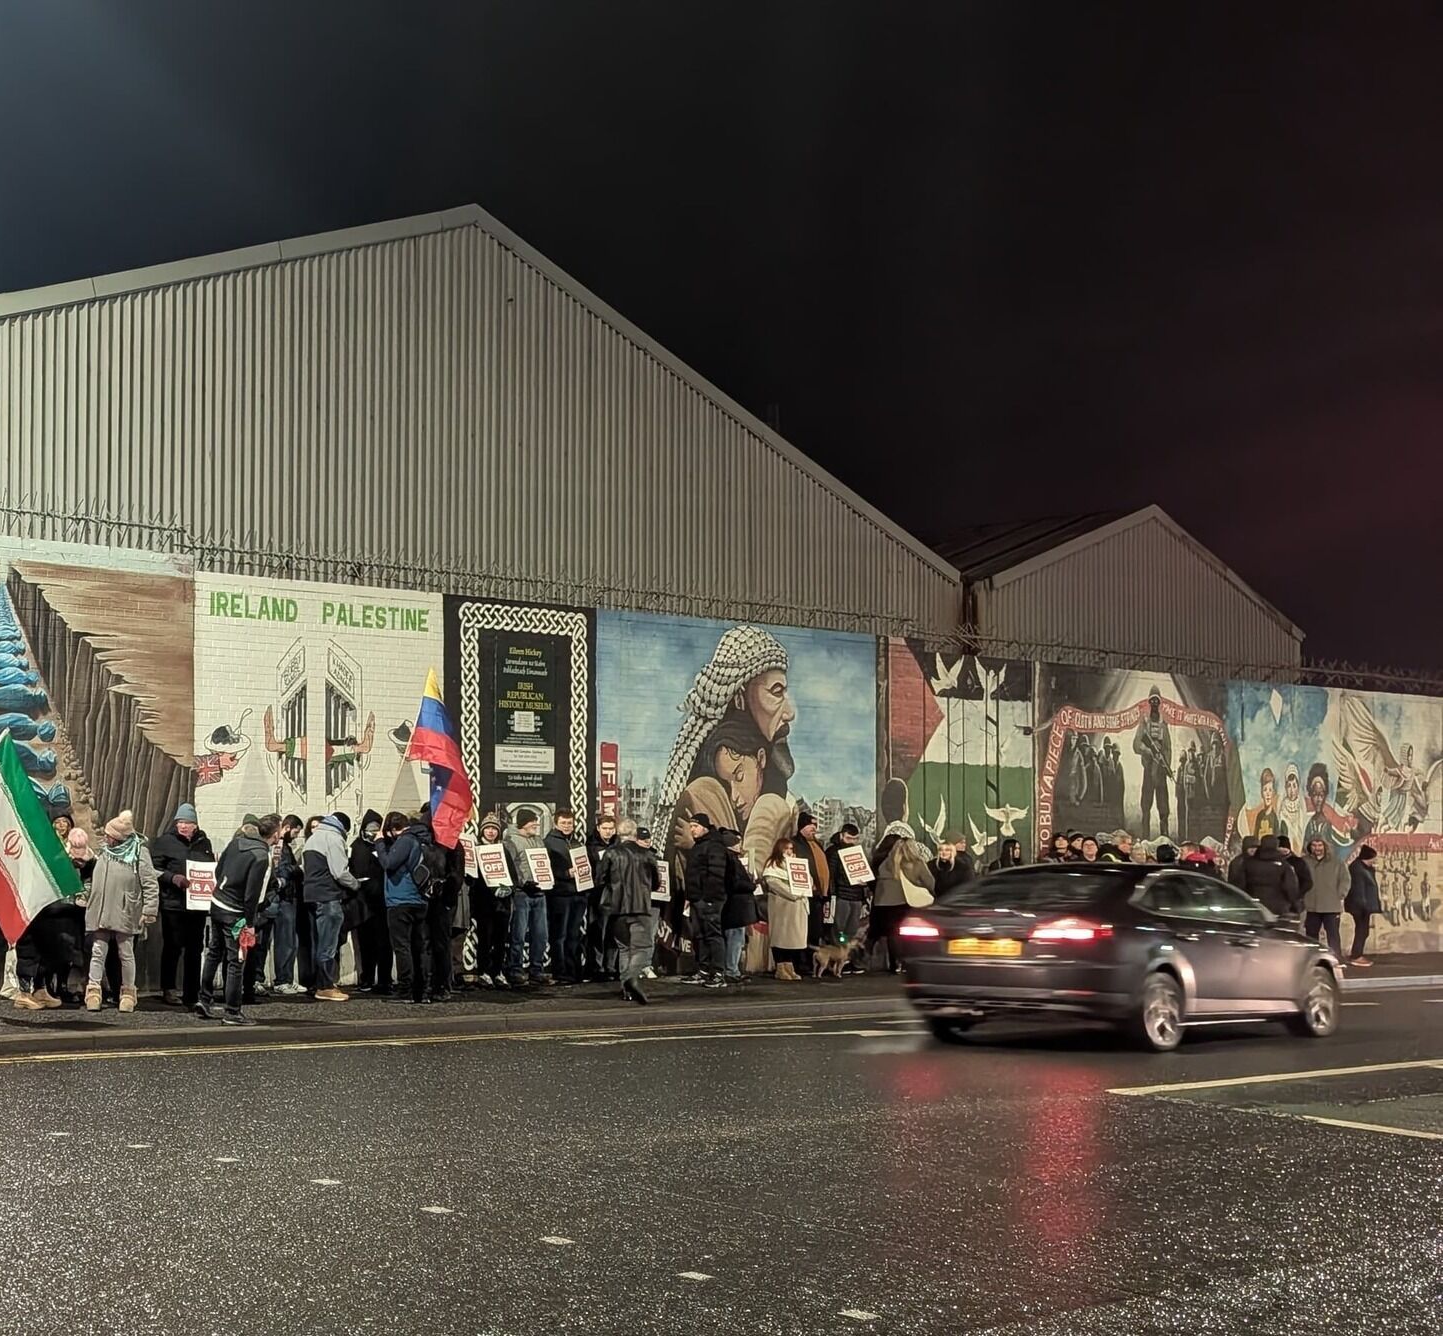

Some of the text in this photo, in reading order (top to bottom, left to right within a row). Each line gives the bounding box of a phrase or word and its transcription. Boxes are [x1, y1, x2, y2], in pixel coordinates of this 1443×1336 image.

[210, 591, 430, 633] IRELAND PALESTINE
[507, 690, 544, 701] REPUBLICAN
[499, 700, 552, 710] HISTORY MUSEUM
[1060, 708, 1072, 725] OF
[1092, 714, 1105, 728] AND
[1040, 724, 1064, 850] TO BUY A PIECE
[484, 862, 504, 872] OFF
[578, 866, 590, 876] OFF
[848, 862, 864, 871] OFF
[192, 882, 212, 892] IS A
